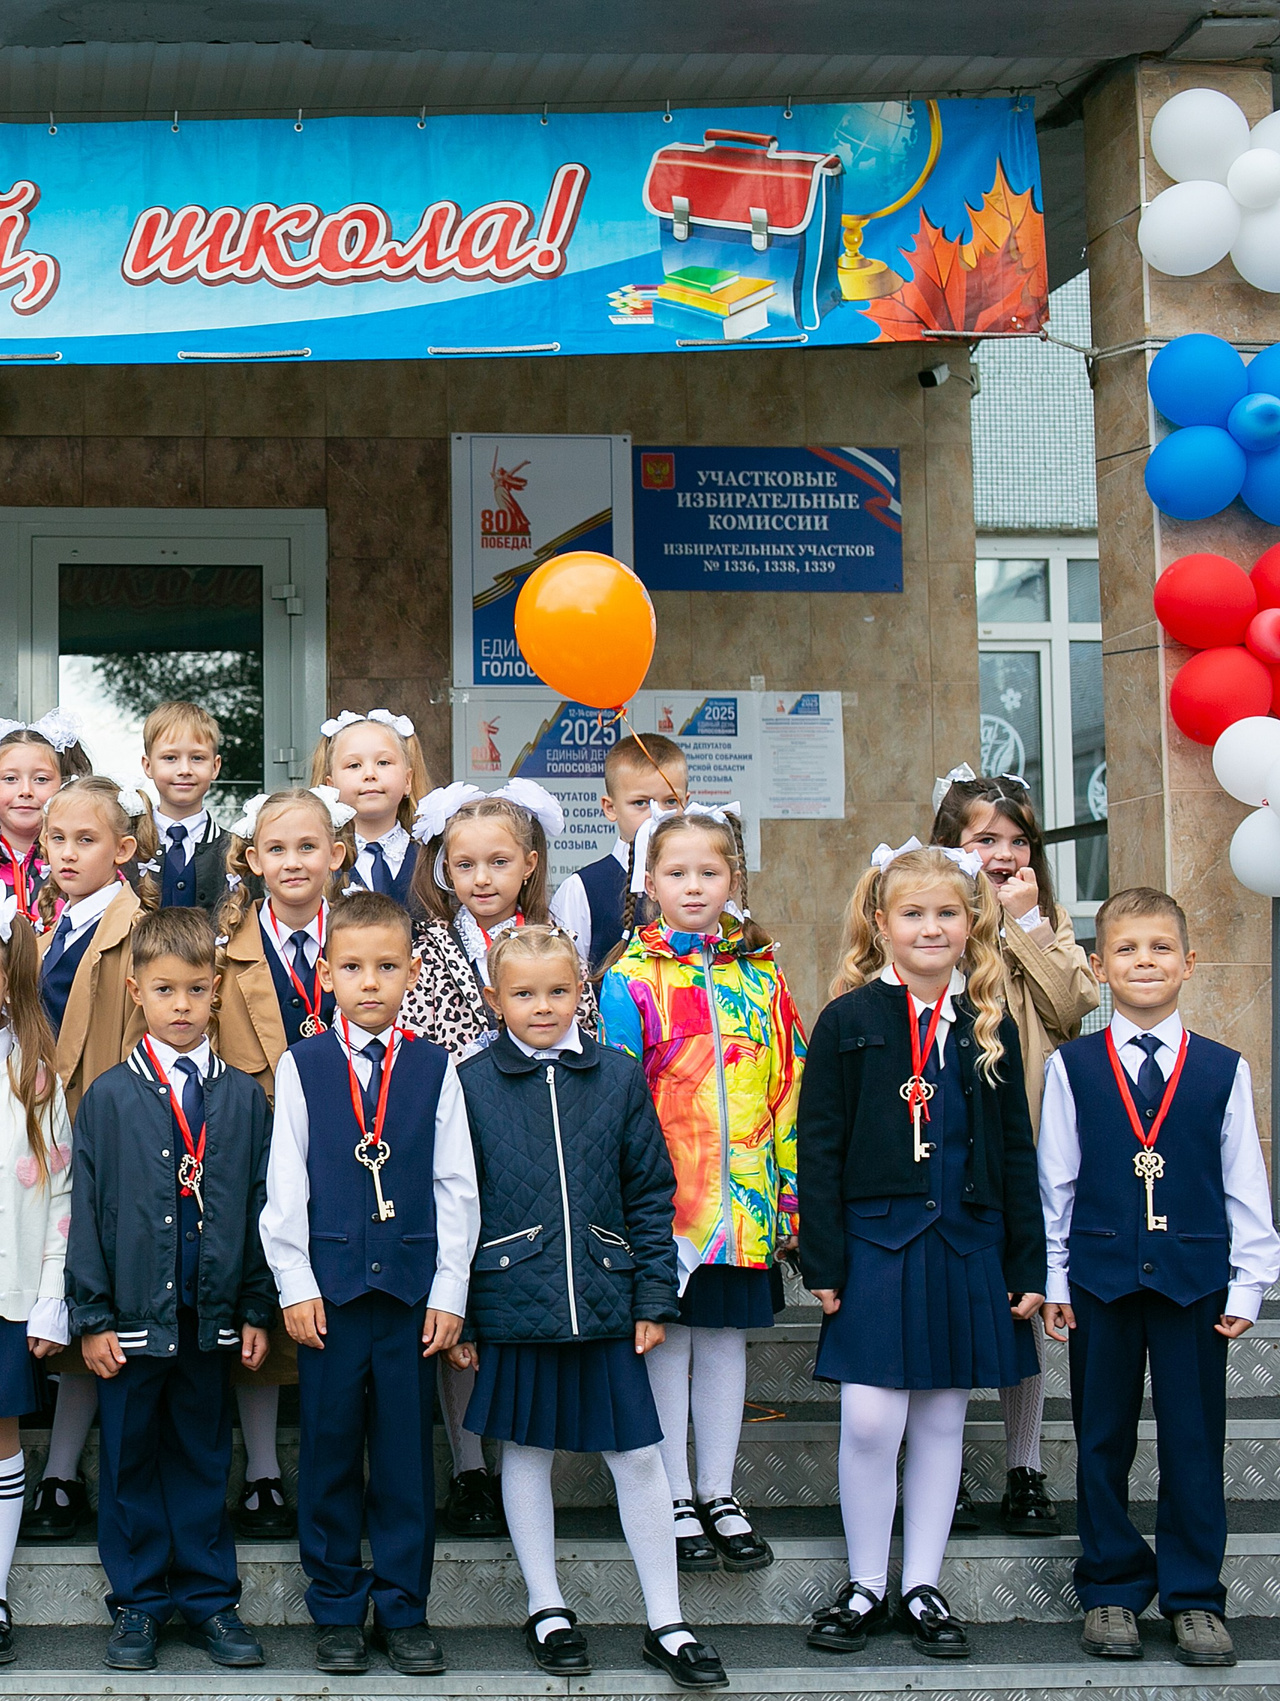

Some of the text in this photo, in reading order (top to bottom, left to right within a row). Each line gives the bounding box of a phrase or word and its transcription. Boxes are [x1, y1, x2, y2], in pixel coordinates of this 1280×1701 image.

[120, 162, 592, 290] школа!
[697, 470, 838, 488] УЧАСТКОВЫЕ
[676, 492, 860, 510] ИЗБИРАТЕЛЬНЫЕ
[481, 509, 508, 532] 80
[708, 514, 830, 531] КОМИССИИ
[481, 537, 532, 551] ПОБЕДА!
[664, 543, 876, 557] ИЗБИРАТЕЛЬНЫХ УЧАСТКОВ
[703, 559, 837, 574] № 1336, 1338, 1339
[704, 705, 736, 721] 2025
[560, 718, 616, 746] 2025
[546, 747, 588, 762] ЕДИНЫЙ
[550, 792, 598, 802] ПУТАТОВ
[569, 824, 616, 834] ОБЛАСТИ
[553, 840, 598, 850] СОЗЫВА
